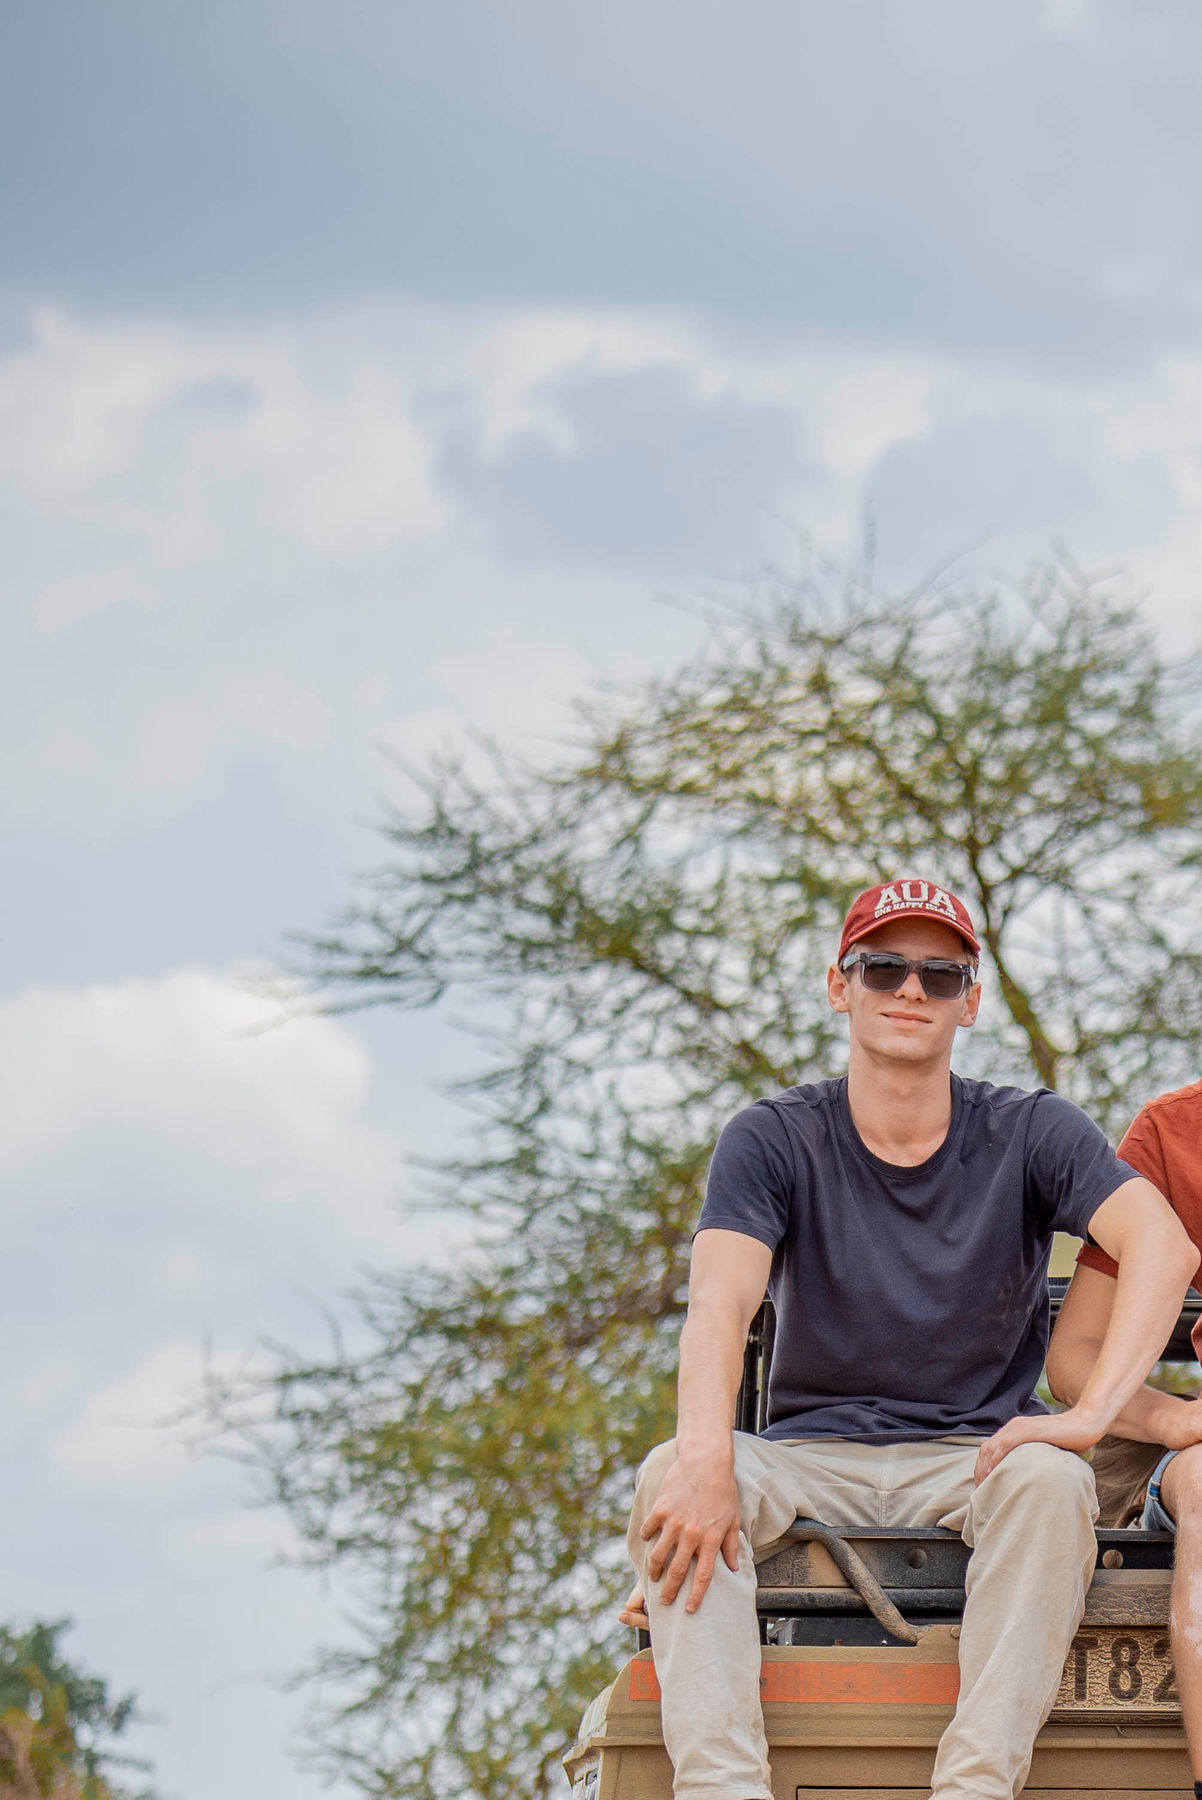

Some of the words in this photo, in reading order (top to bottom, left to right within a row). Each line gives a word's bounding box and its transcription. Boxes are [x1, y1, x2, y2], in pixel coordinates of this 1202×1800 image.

[874, 881, 957, 916] AUA
[893, 902, 924, 911] HAPPY
[1070, 1637, 1180, 1702] T82
